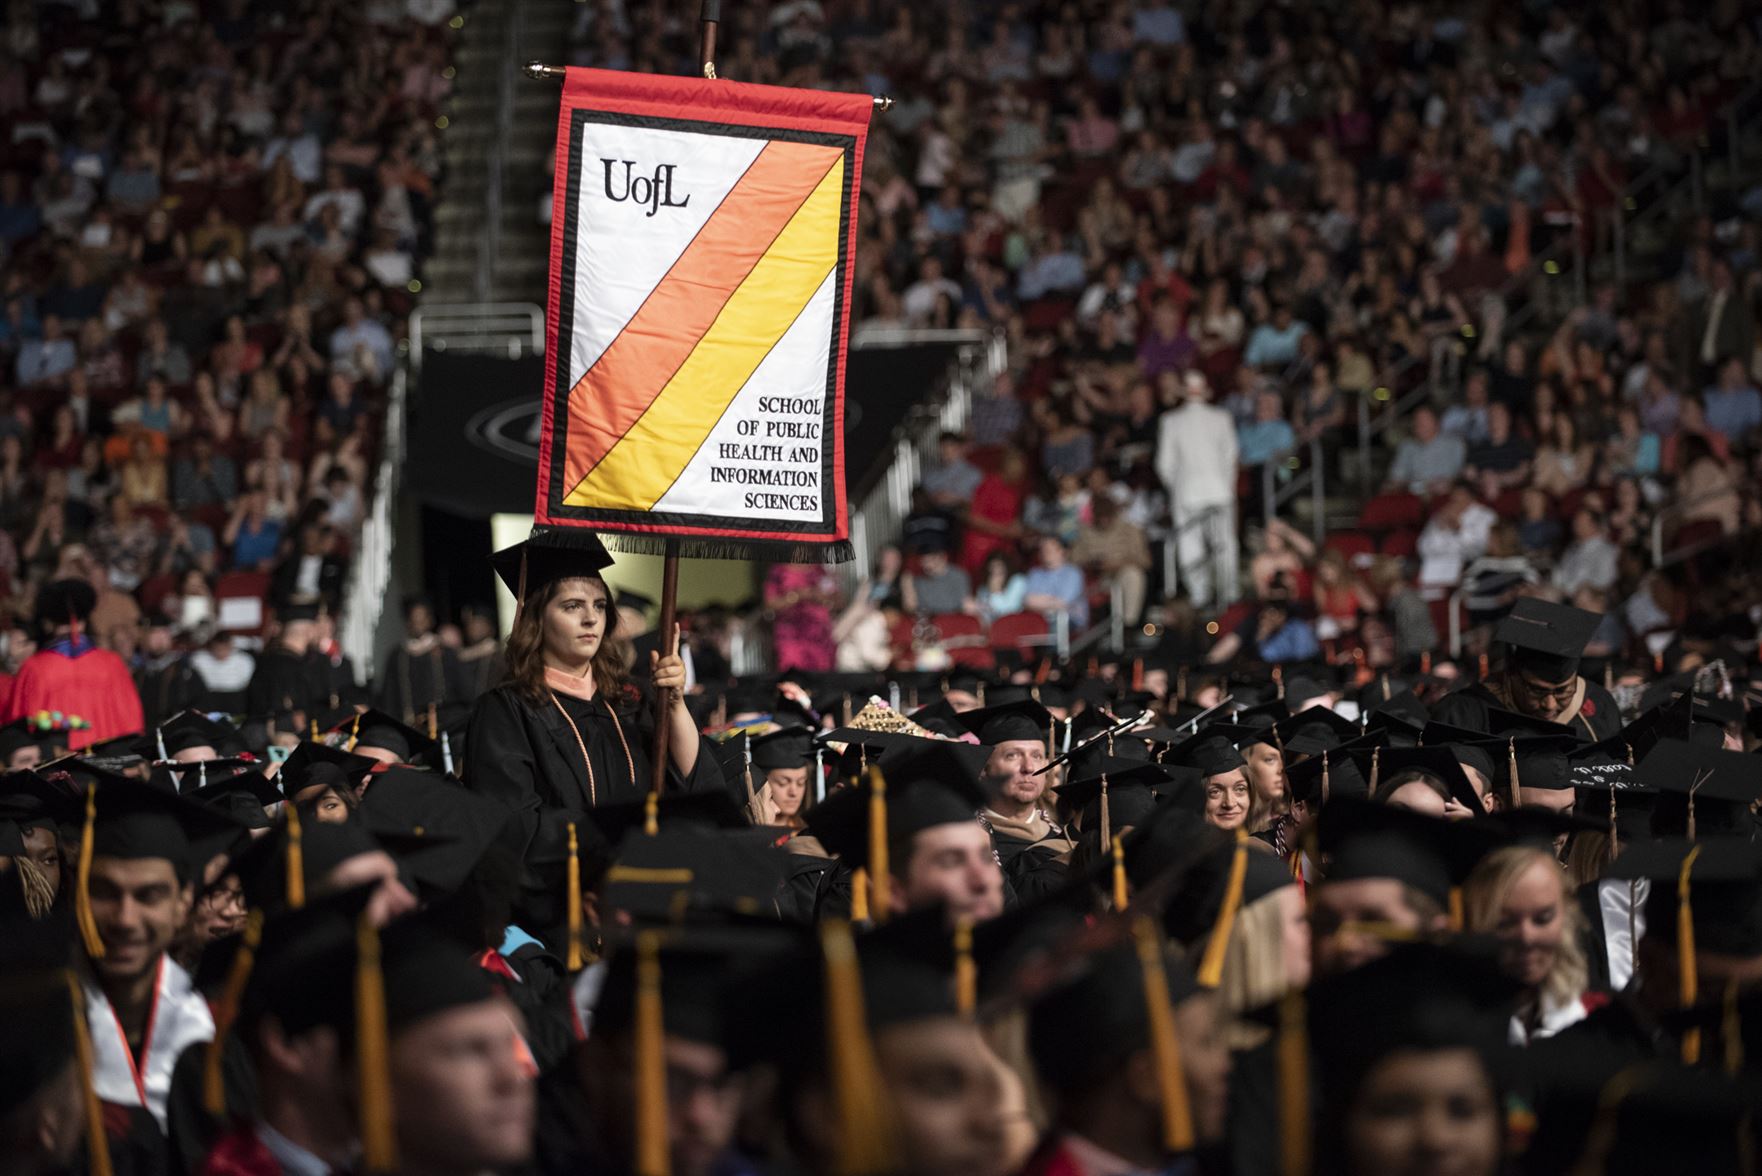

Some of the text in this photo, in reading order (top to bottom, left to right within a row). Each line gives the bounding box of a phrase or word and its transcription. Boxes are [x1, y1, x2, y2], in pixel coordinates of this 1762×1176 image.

[599, 157, 690, 217] UofL
[758, 396, 821, 415] SCHOOL
[737, 420, 820, 440] OF PUBLIC
[719, 443, 819, 463] HEALTH AND
[710, 466, 818, 487] INFORMATION
[744, 492, 818, 512] SCIENCES
